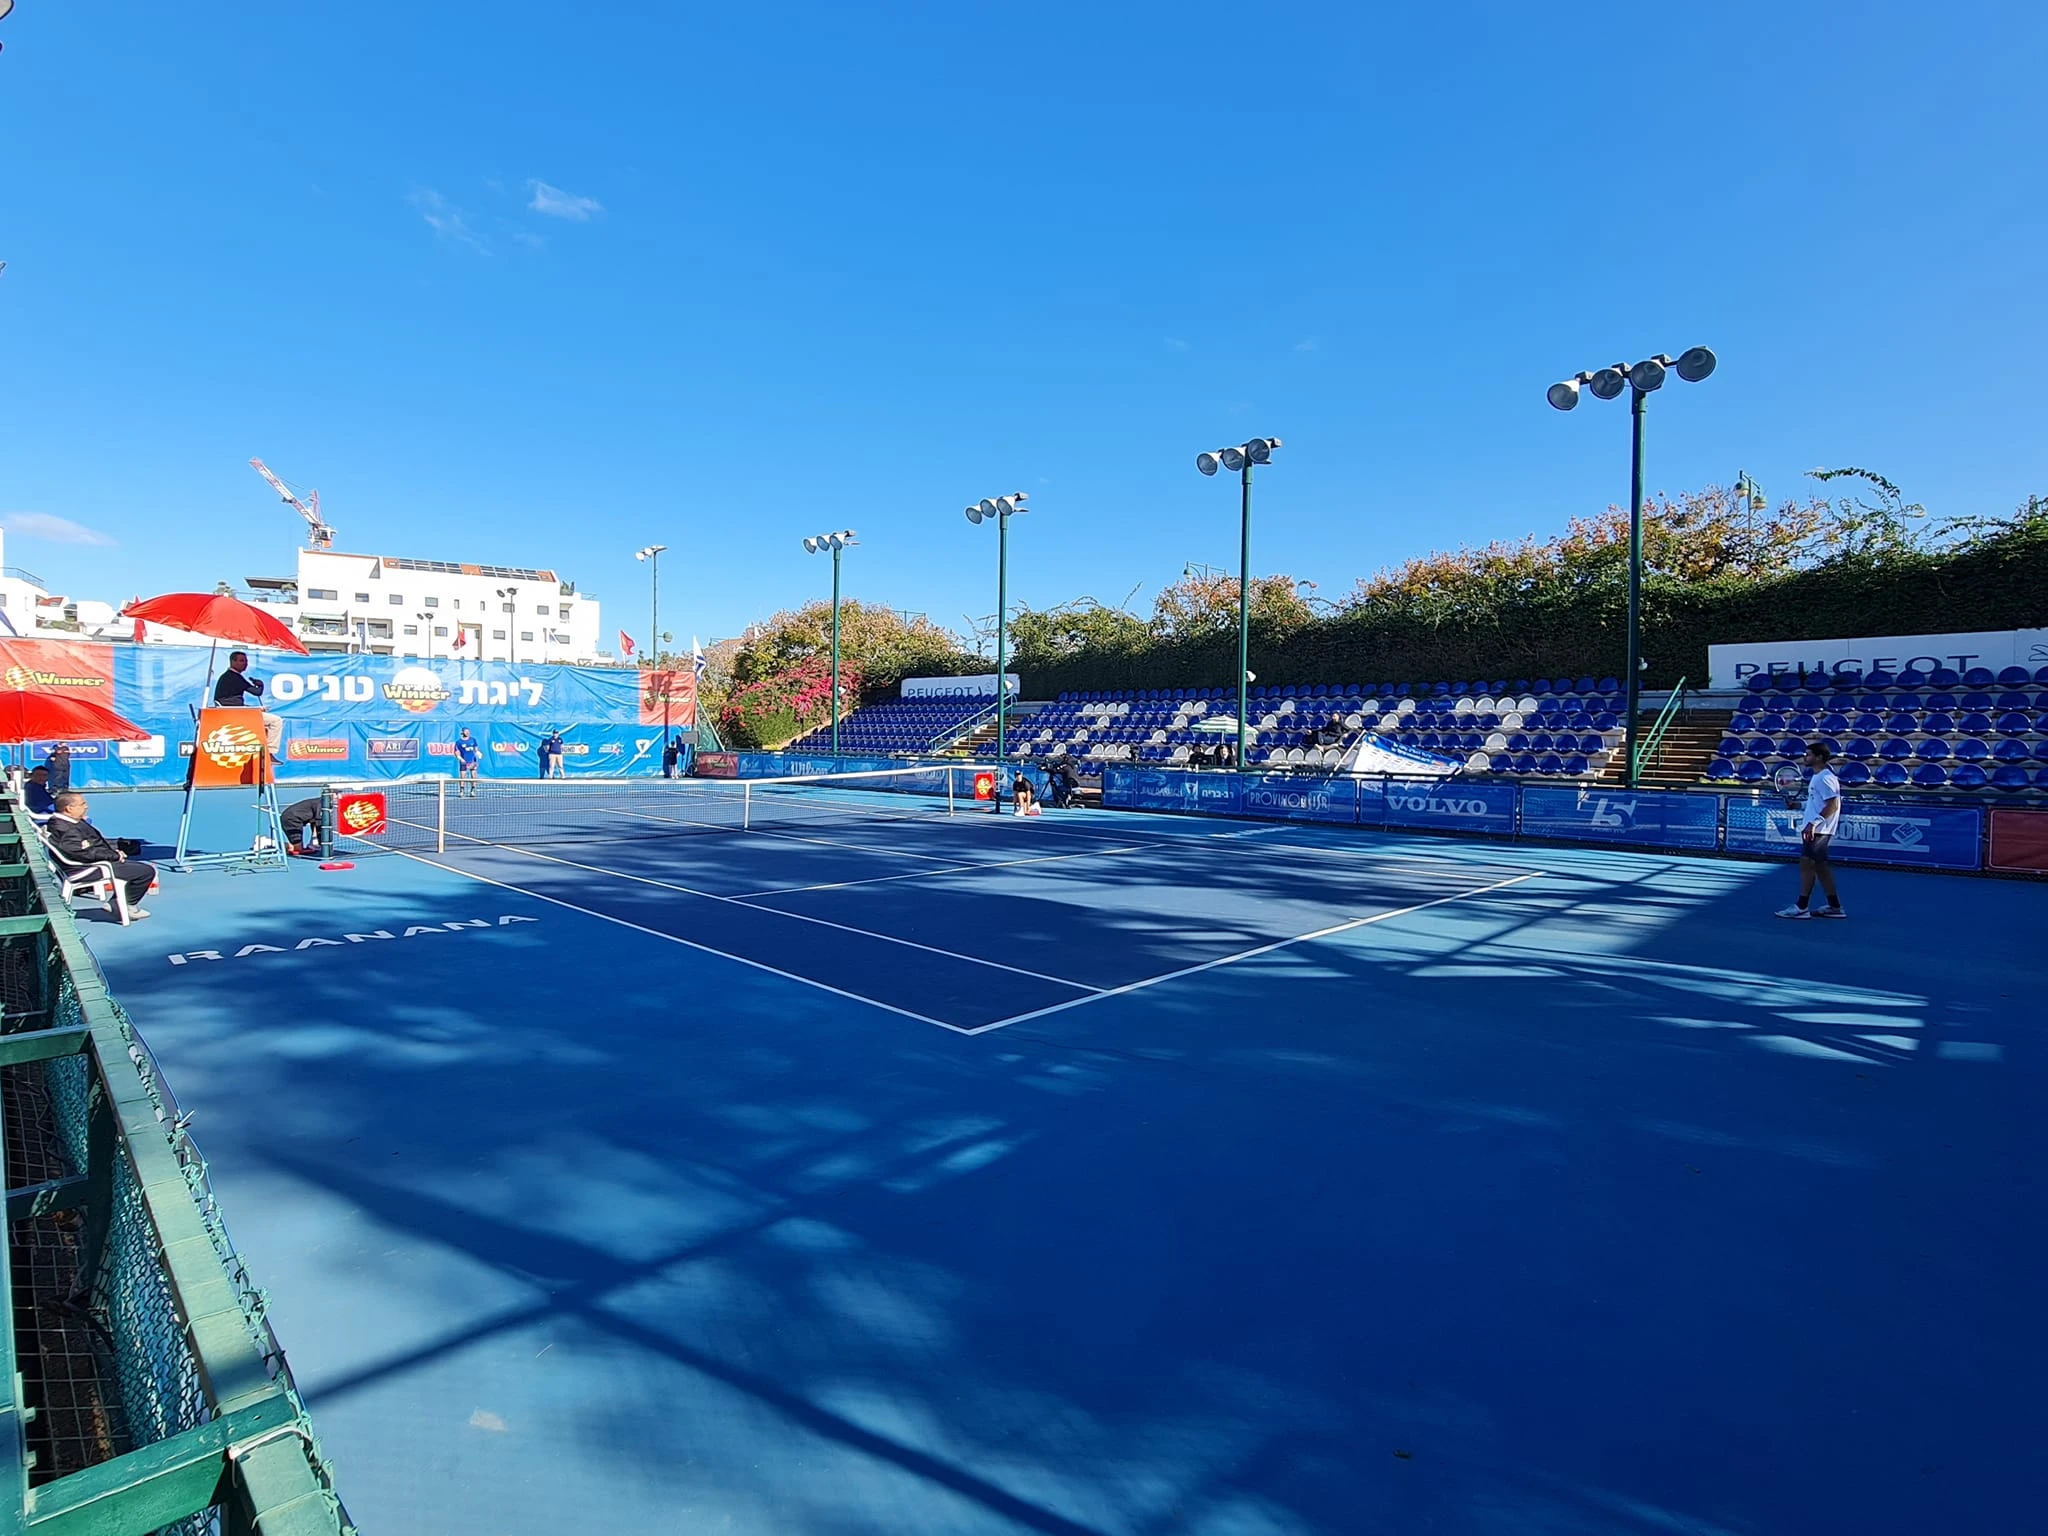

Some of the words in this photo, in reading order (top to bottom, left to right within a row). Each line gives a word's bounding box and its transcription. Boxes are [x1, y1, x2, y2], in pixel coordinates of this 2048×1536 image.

[1735, 655, 1980, 679] PEUGEOT
[33, 671, 105, 686] Winner
[270, 673, 374, 702] טניס
[382, 683, 451, 701] Winner
[458, 677, 544, 706] ליגת
[907, 687, 973, 697] PEUGEOT
[41, 746, 98, 754] VLVO
[202, 741, 264, 754] Winner
[306, 745, 346, 754] Winner
[791, 761, 829, 775] Wilson
[1384, 796, 1487, 815] VOLVO
[167, 914, 540, 966] RAANANA
